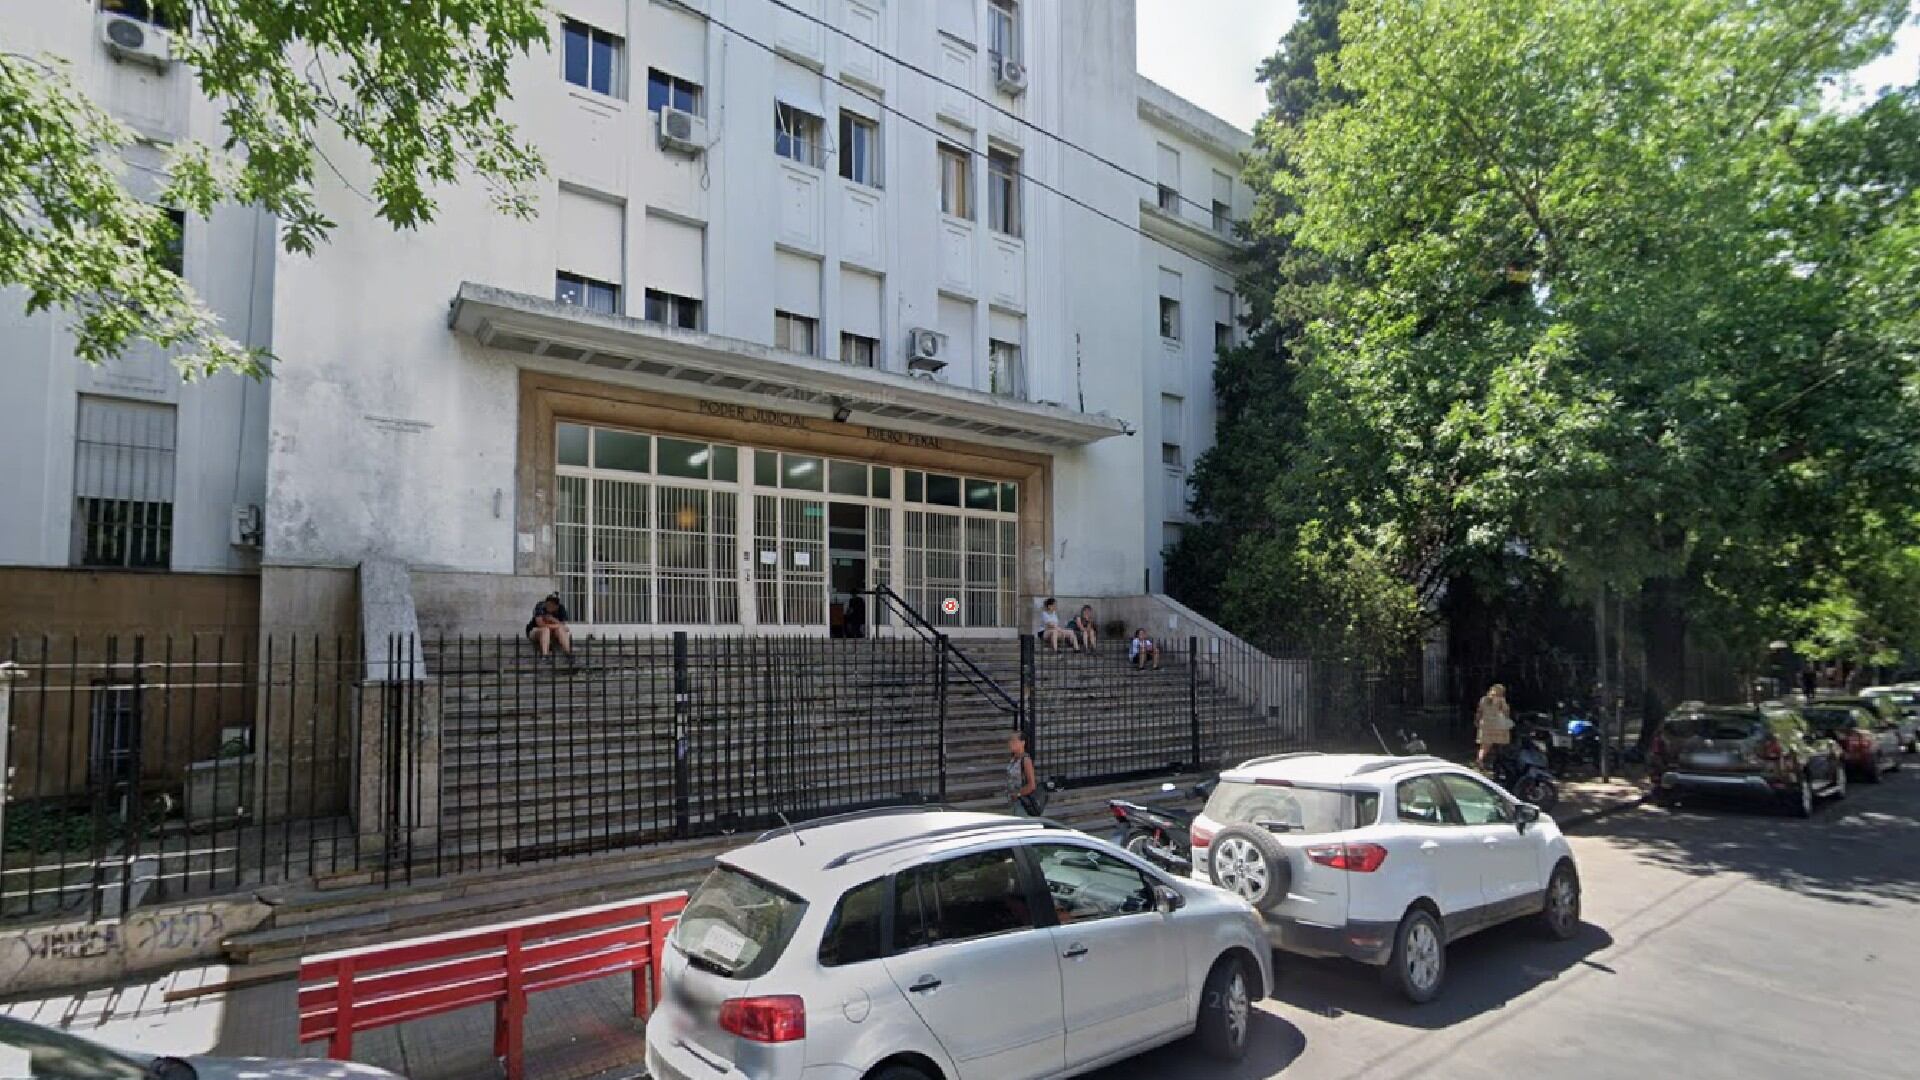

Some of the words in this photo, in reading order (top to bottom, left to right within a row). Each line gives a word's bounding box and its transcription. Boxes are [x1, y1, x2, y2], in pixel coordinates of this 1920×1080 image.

[699, 400, 745, 418] PODER
[752, 408, 807, 427] JUDICIAL
[866, 426, 903, 443] FUERO
[908, 432, 942, 449] PENAL
